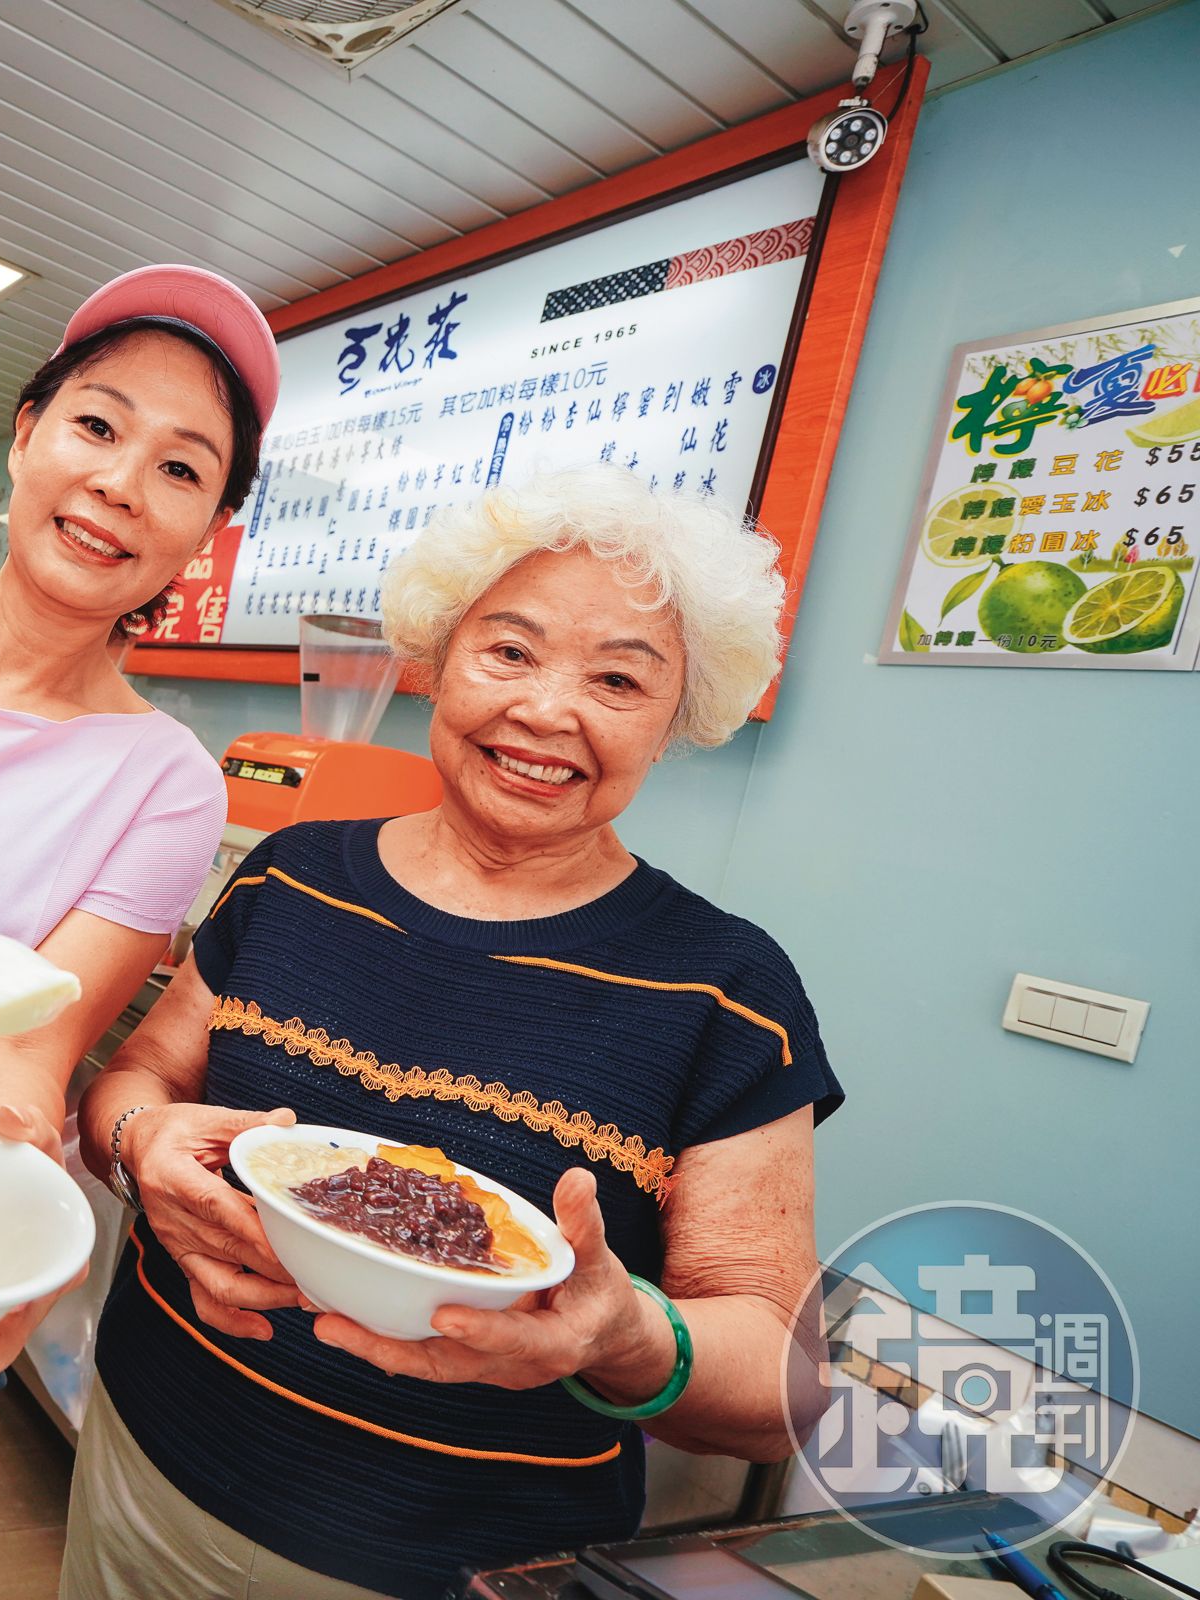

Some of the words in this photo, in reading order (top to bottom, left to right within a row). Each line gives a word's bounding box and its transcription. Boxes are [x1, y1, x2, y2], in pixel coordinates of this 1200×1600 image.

[531, 337, 583, 358] SINCE
[594, 323, 638, 344] 1965
[439, 361, 609, 419] 其它加料每樣10元
[755, 367, 773, 391] 冰
[970, 450, 1124, 483] 檸檬豆花
[960, 490, 1113, 520] 檸檬愛玉冰
[1134, 484, 1196, 507] $65
[951, 529, 1101, 556] 檸檬粉圓冰
[1123, 526, 1184, 547] $65
[916, 630, 1057, 649] 加檸檬一份10元
